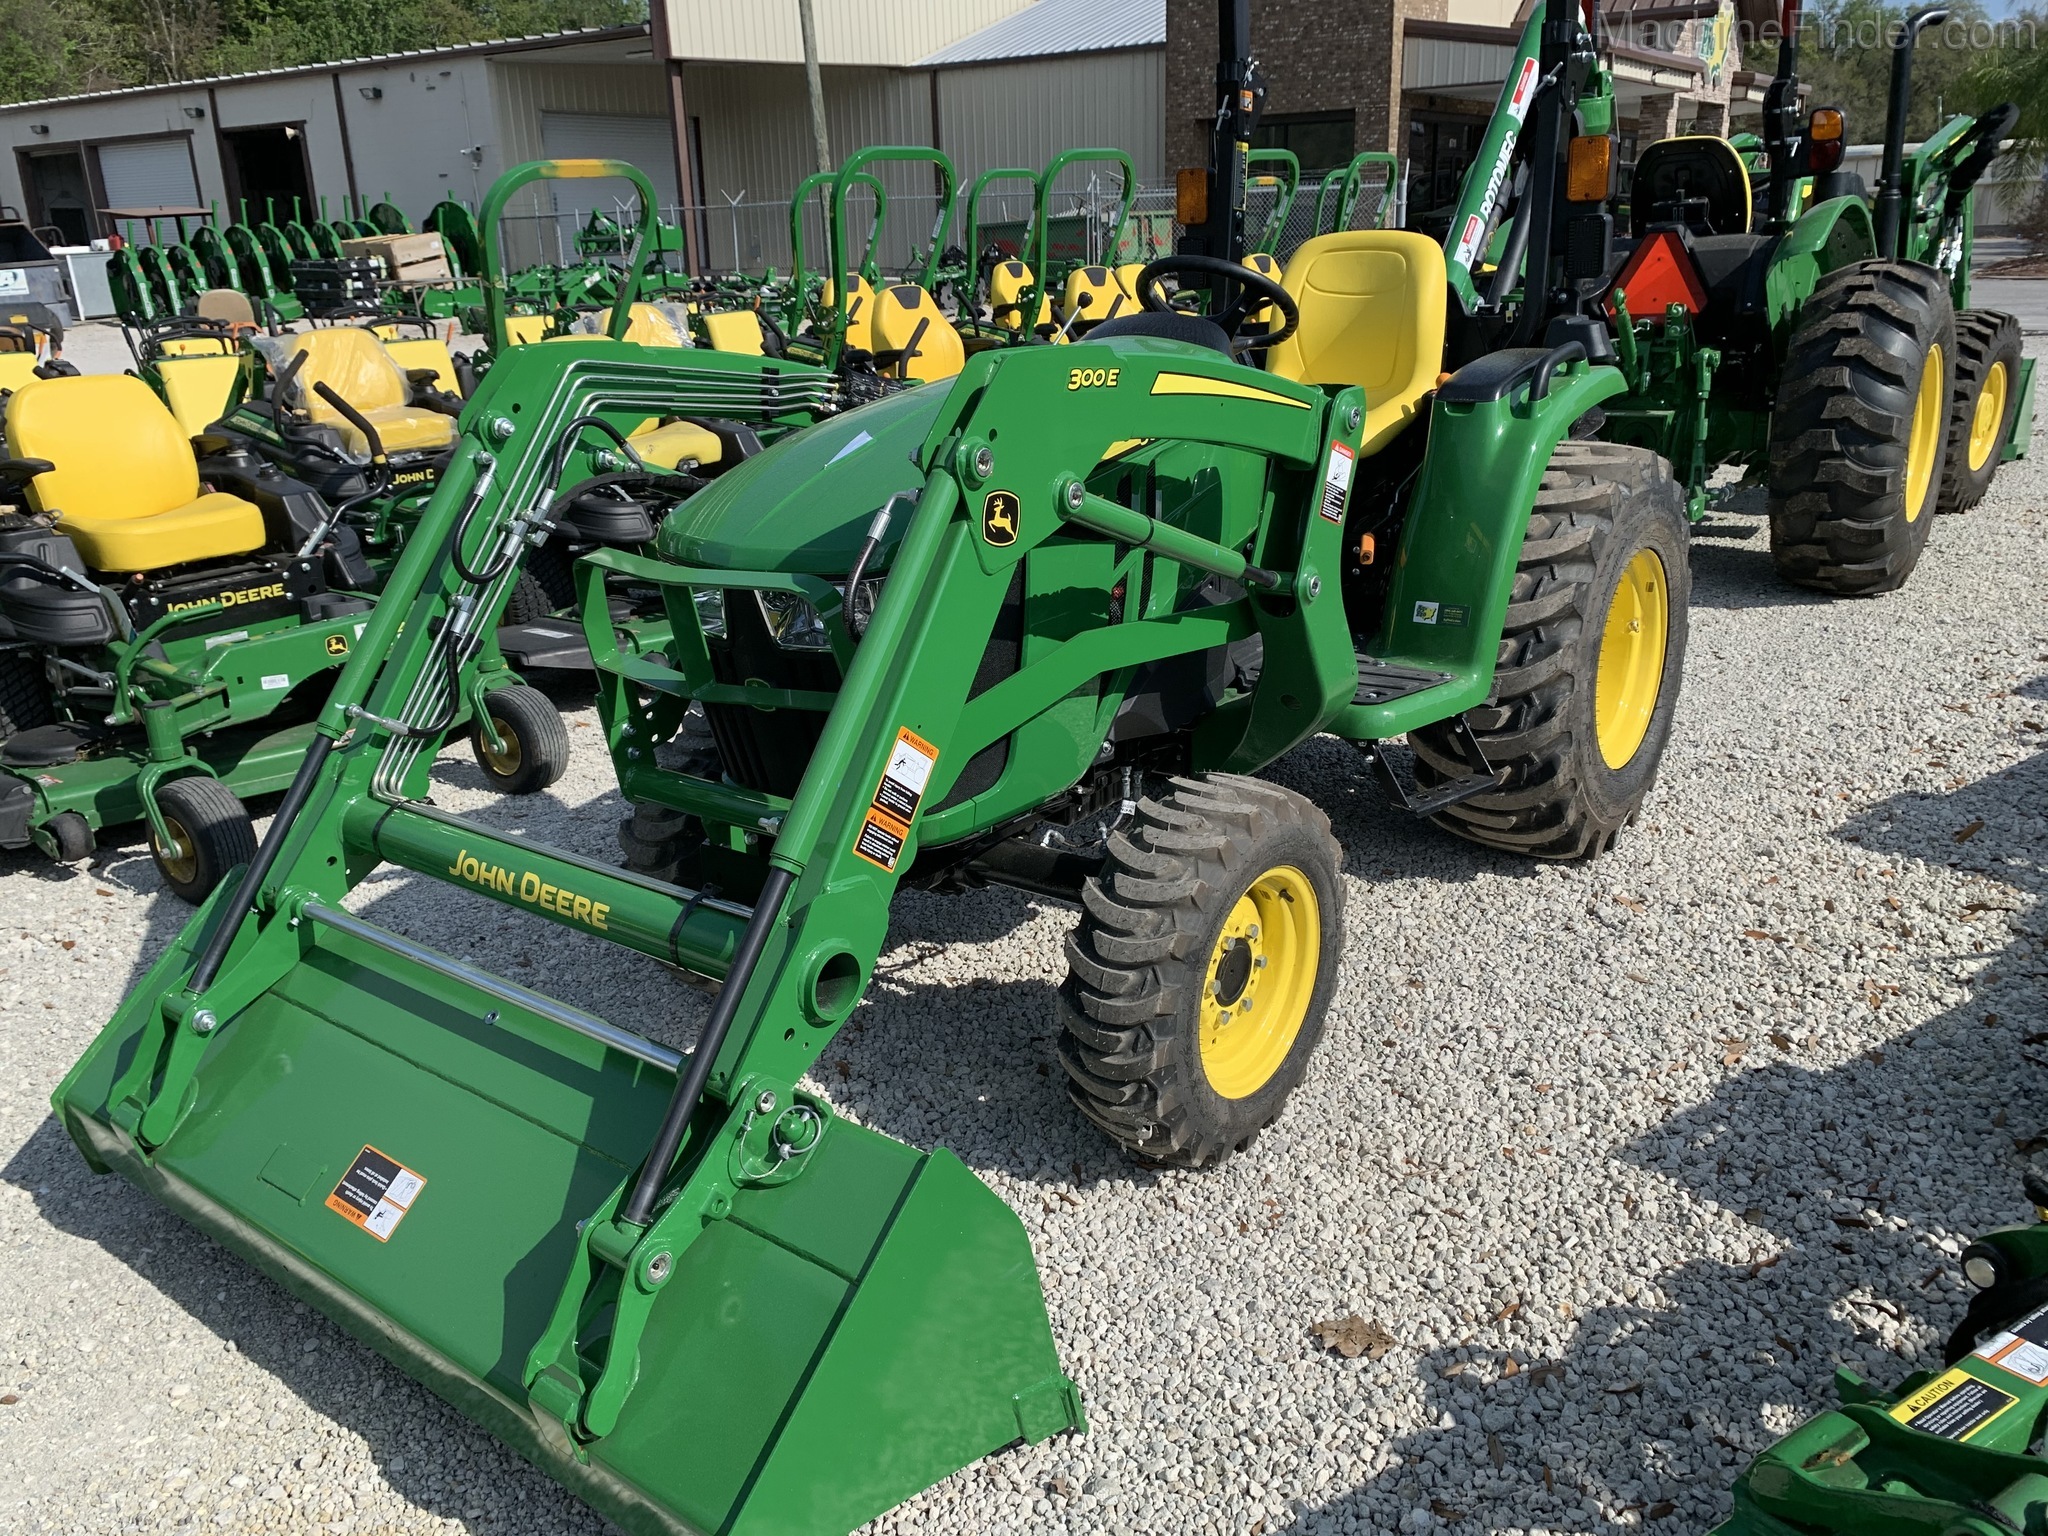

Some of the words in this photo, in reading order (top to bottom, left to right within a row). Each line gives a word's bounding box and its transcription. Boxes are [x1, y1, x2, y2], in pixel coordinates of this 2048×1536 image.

[1480, 130, 1517, 220] ROTOMEC
[392, 472, 424, 484] JOHN
[220, 583, 284, 607] DEERE
[909, 736, 934, 756] WARNING
[878, 817, 904, 836] WARNING
[448, 849, 516, 896] JOHN
[520, 872, 610, 930] DEERE
[332, 1199, 356, 1218] WARNING
[1915, 1379, 1955, 1407] CAUTION
